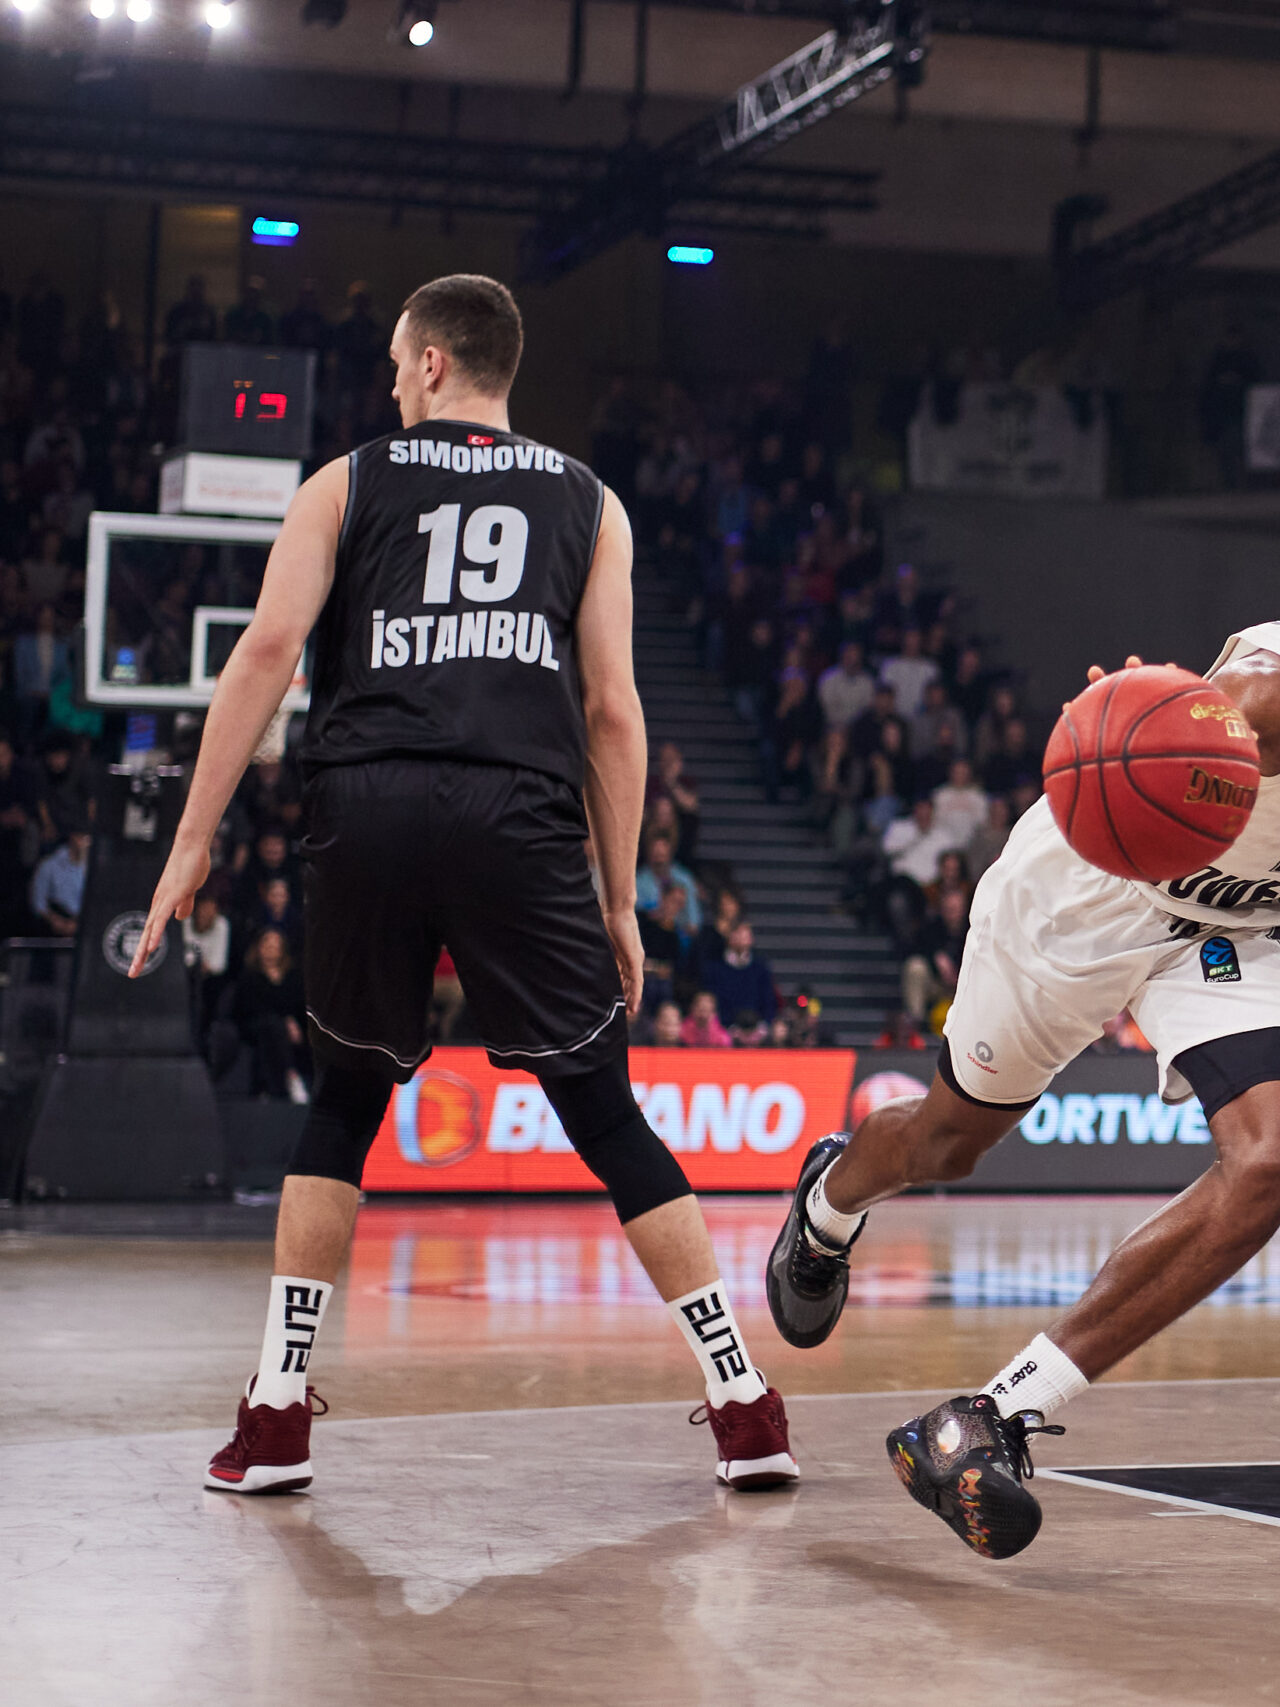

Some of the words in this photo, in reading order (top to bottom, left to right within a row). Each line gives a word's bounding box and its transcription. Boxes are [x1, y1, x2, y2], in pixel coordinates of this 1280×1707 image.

[389, 439, 564, 474] SIMONOVIC
[418, 503, 529, 604] 19
[371, 609, 560, 672] İSTANBUL
